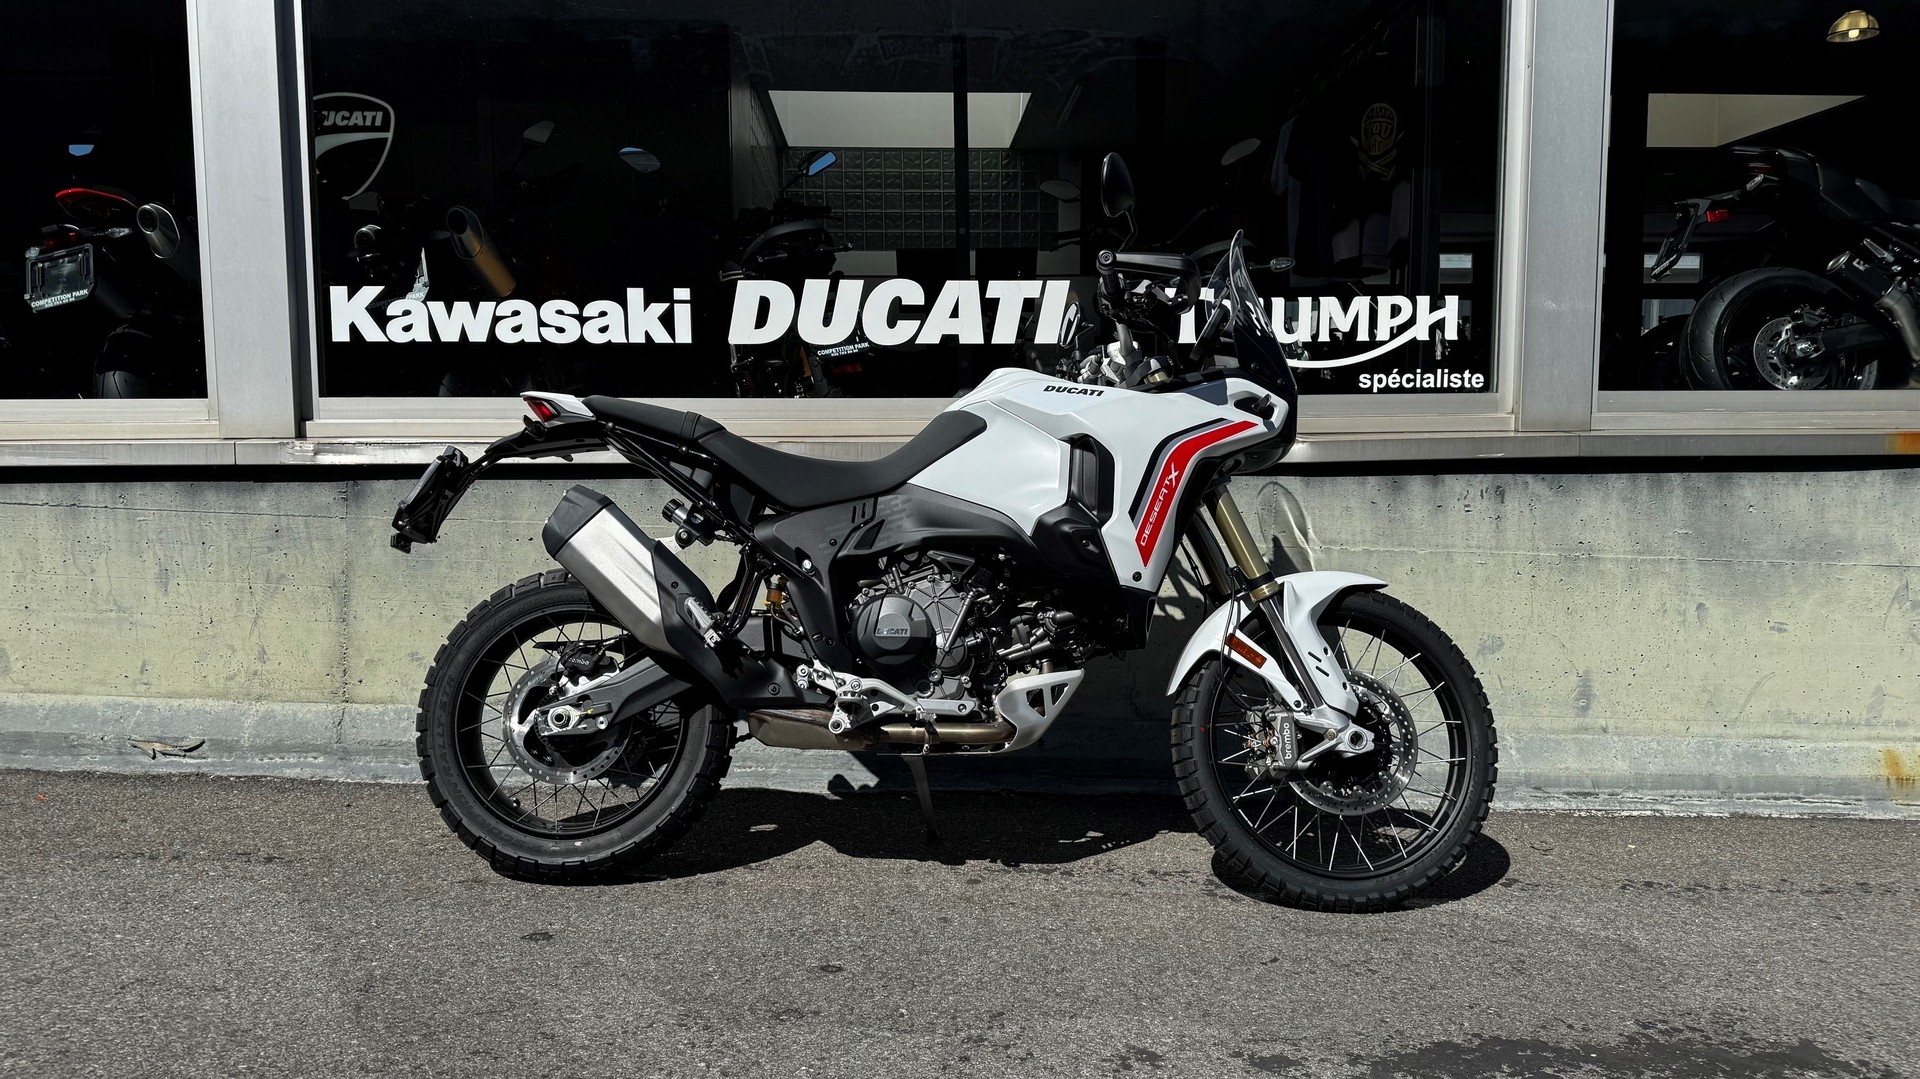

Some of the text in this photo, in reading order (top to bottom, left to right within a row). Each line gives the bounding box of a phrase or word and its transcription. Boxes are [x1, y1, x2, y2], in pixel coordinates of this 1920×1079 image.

[322, 110, 384, 127] UCATI
[31, 293, 72, 308] COMPETITION
[72, 288, 88, 298] PARK
[330, 286, 692, 344] Kawasaki
[728, 279, 1070, 345] DUCATI
[1165, 287, 1459, 344] TUMPH
[817, 345, 854, 356] COMPETITION
[854, 341, 870, 350] PARK
[1043, 385, 1105, 397] DUCATI
[1358, 368, 1485, 393] spécialiste
[876, 627, 909, 636] DUCATI
[1283, 722, 1292, 760] brembo
